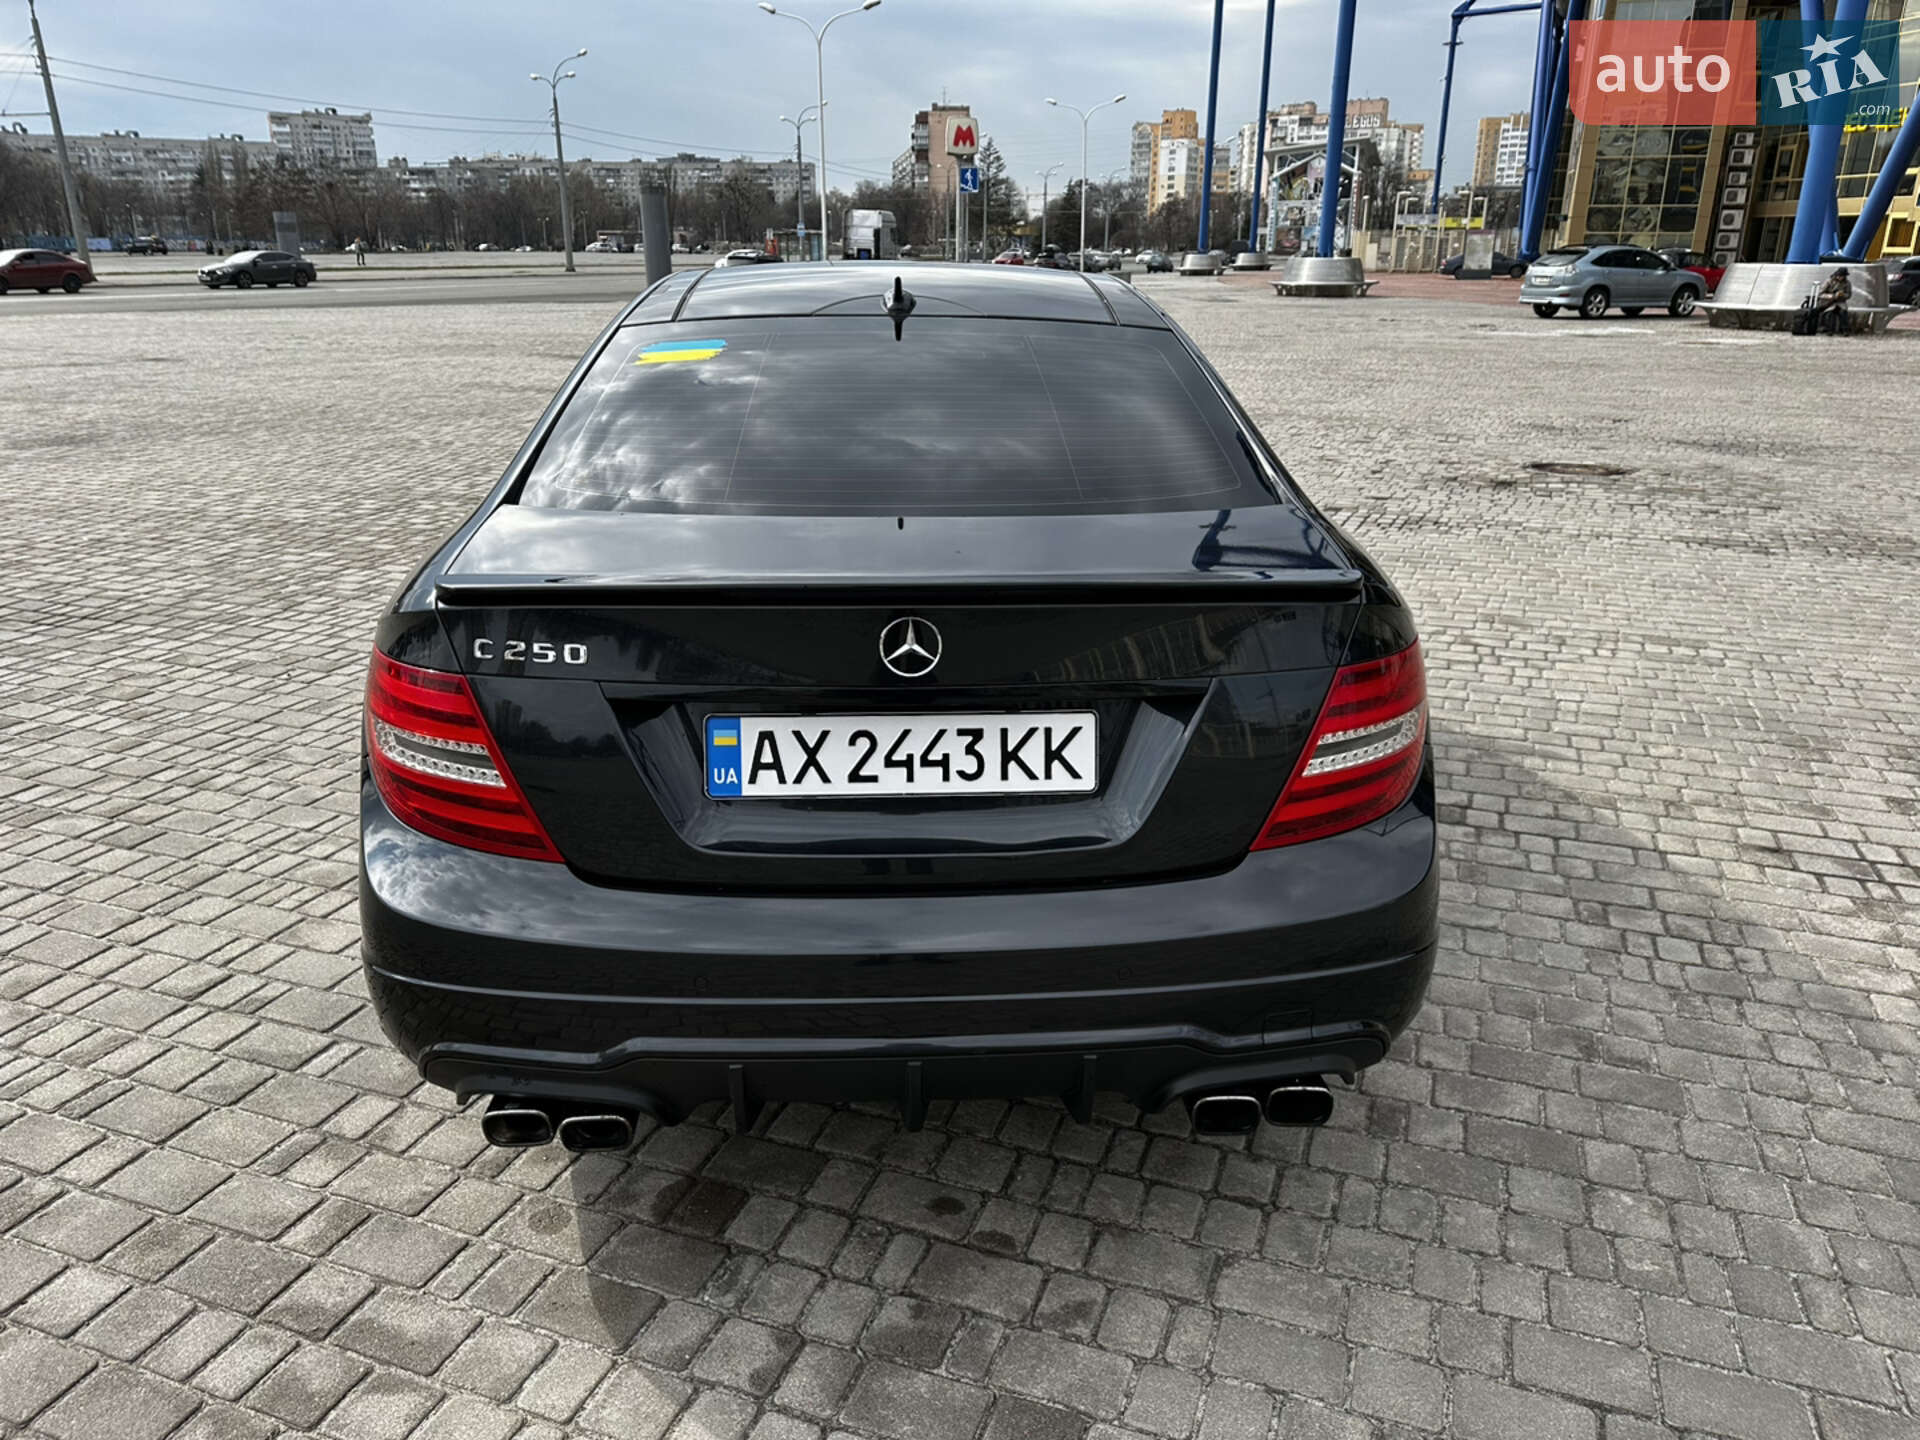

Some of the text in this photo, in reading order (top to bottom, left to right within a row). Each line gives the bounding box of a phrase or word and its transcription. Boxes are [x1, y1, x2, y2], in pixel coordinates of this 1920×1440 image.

[953, 125, 975, 148] M
[473, 638, 588, 664] C 250
[748, 726, 1083, 784] AX 2443 KK
[713, 767, 738, 784] UA
